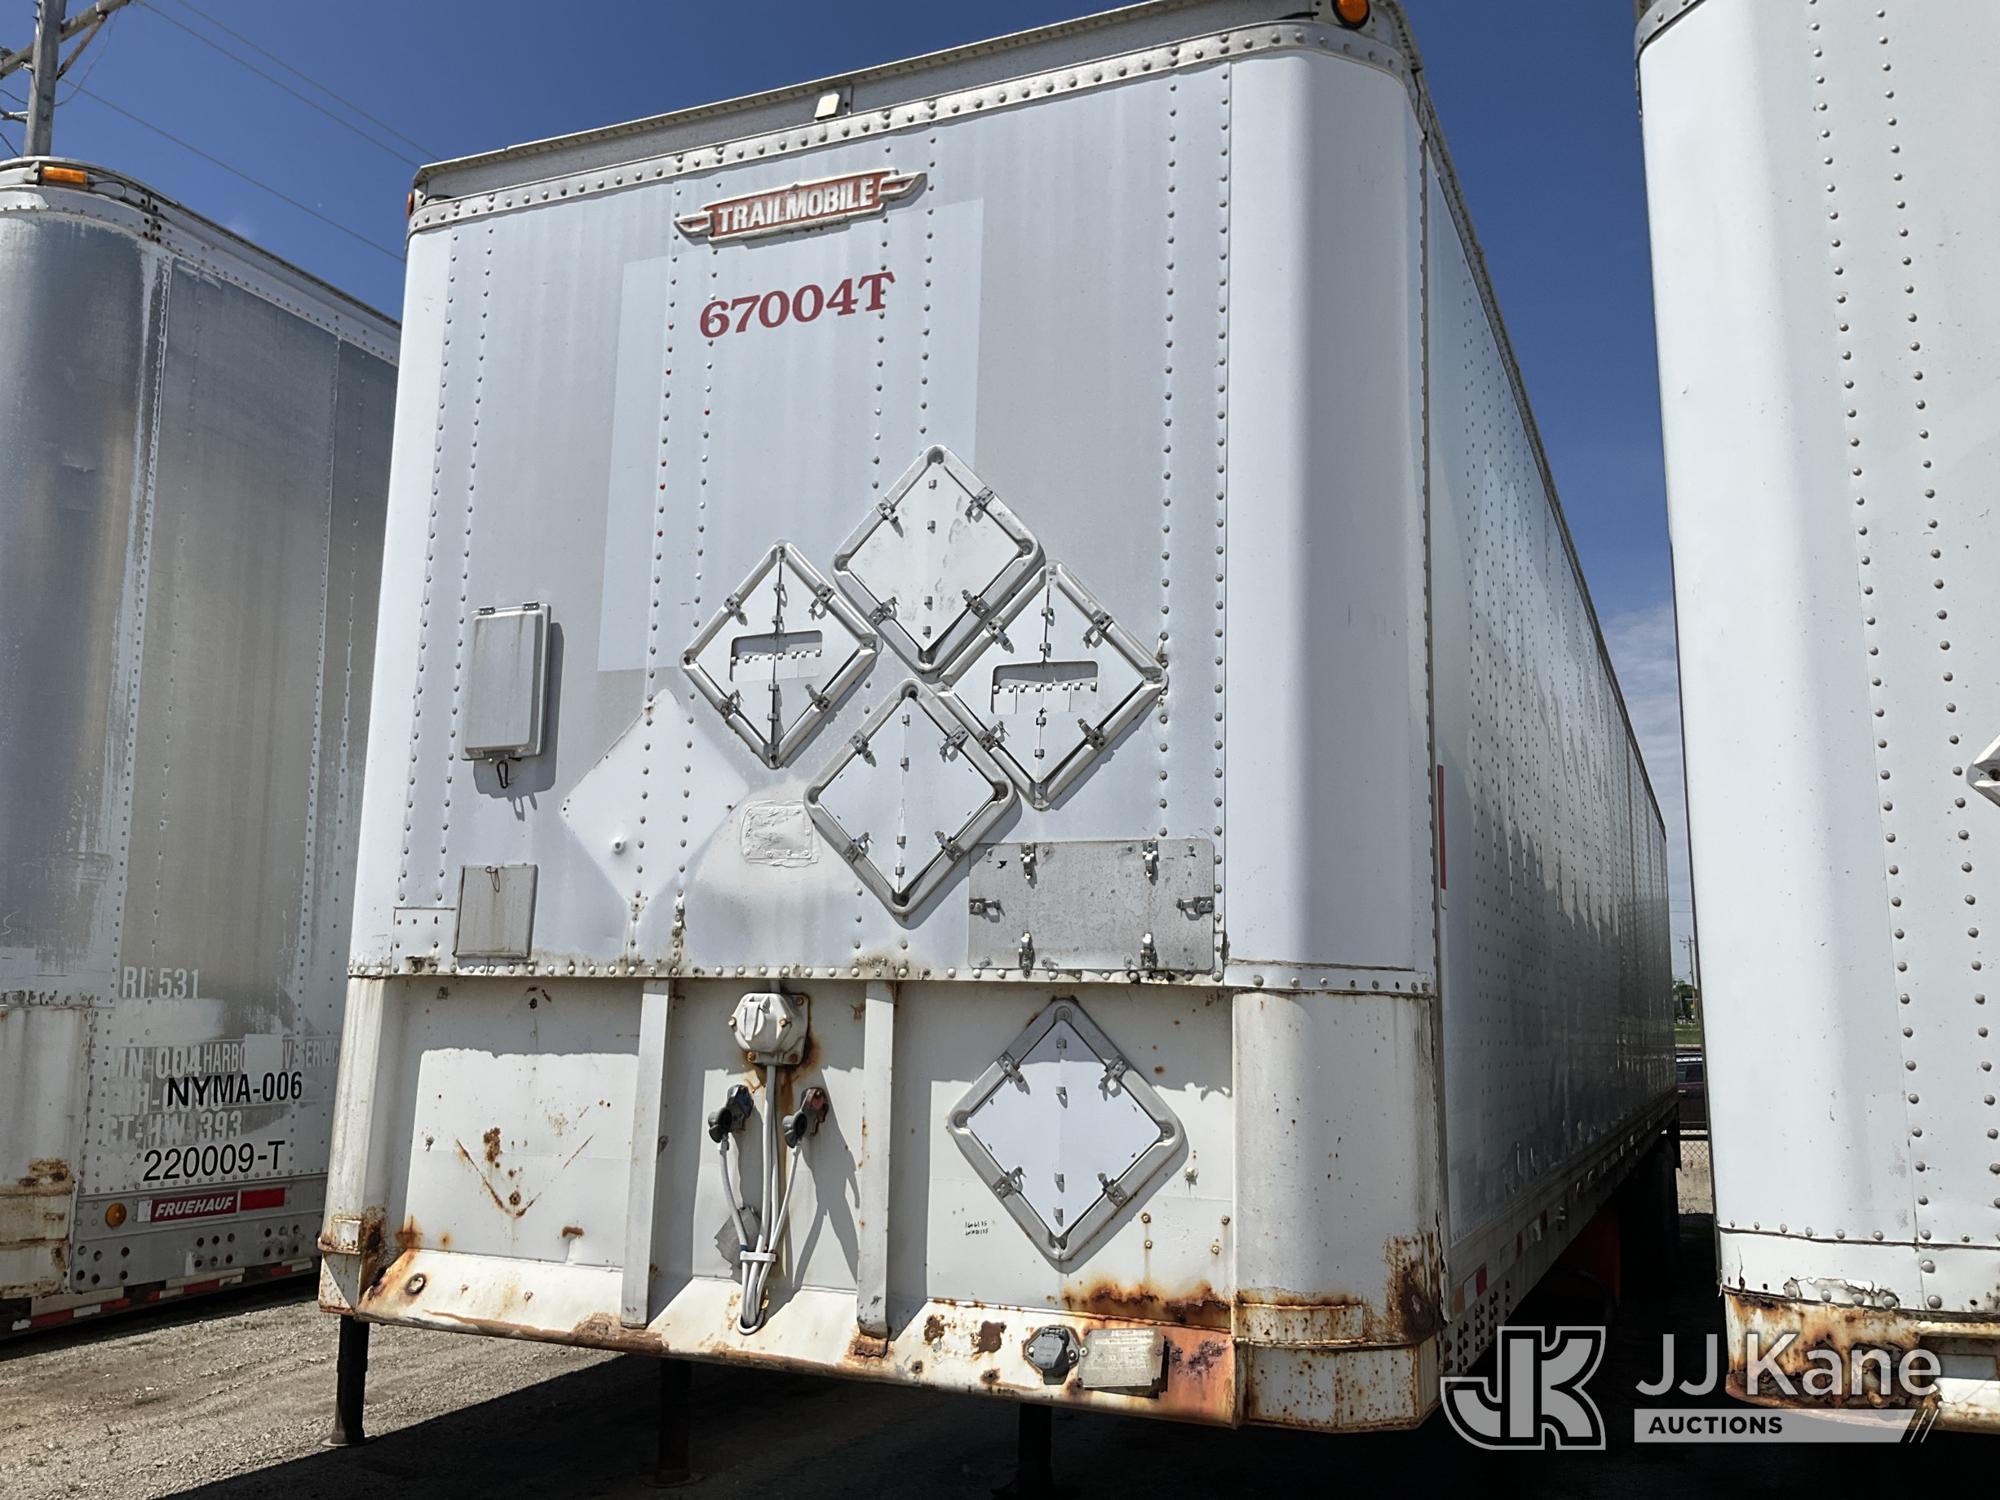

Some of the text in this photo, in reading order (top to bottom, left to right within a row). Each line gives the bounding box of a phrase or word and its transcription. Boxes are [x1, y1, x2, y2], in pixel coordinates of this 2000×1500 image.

[718, 177, 875, 231] TRAILMOBILE
[699, 271, 896, 338] 67004T
[122, 966, 200, 999] RI 531
[166, 1070, 303, 1107] NYMA-006
[198, 1110, 243, 1142] 393
[142, 1140, 286, 1182] 220009-T
[155, 1196, 235, 1218] FRUEHAUF
